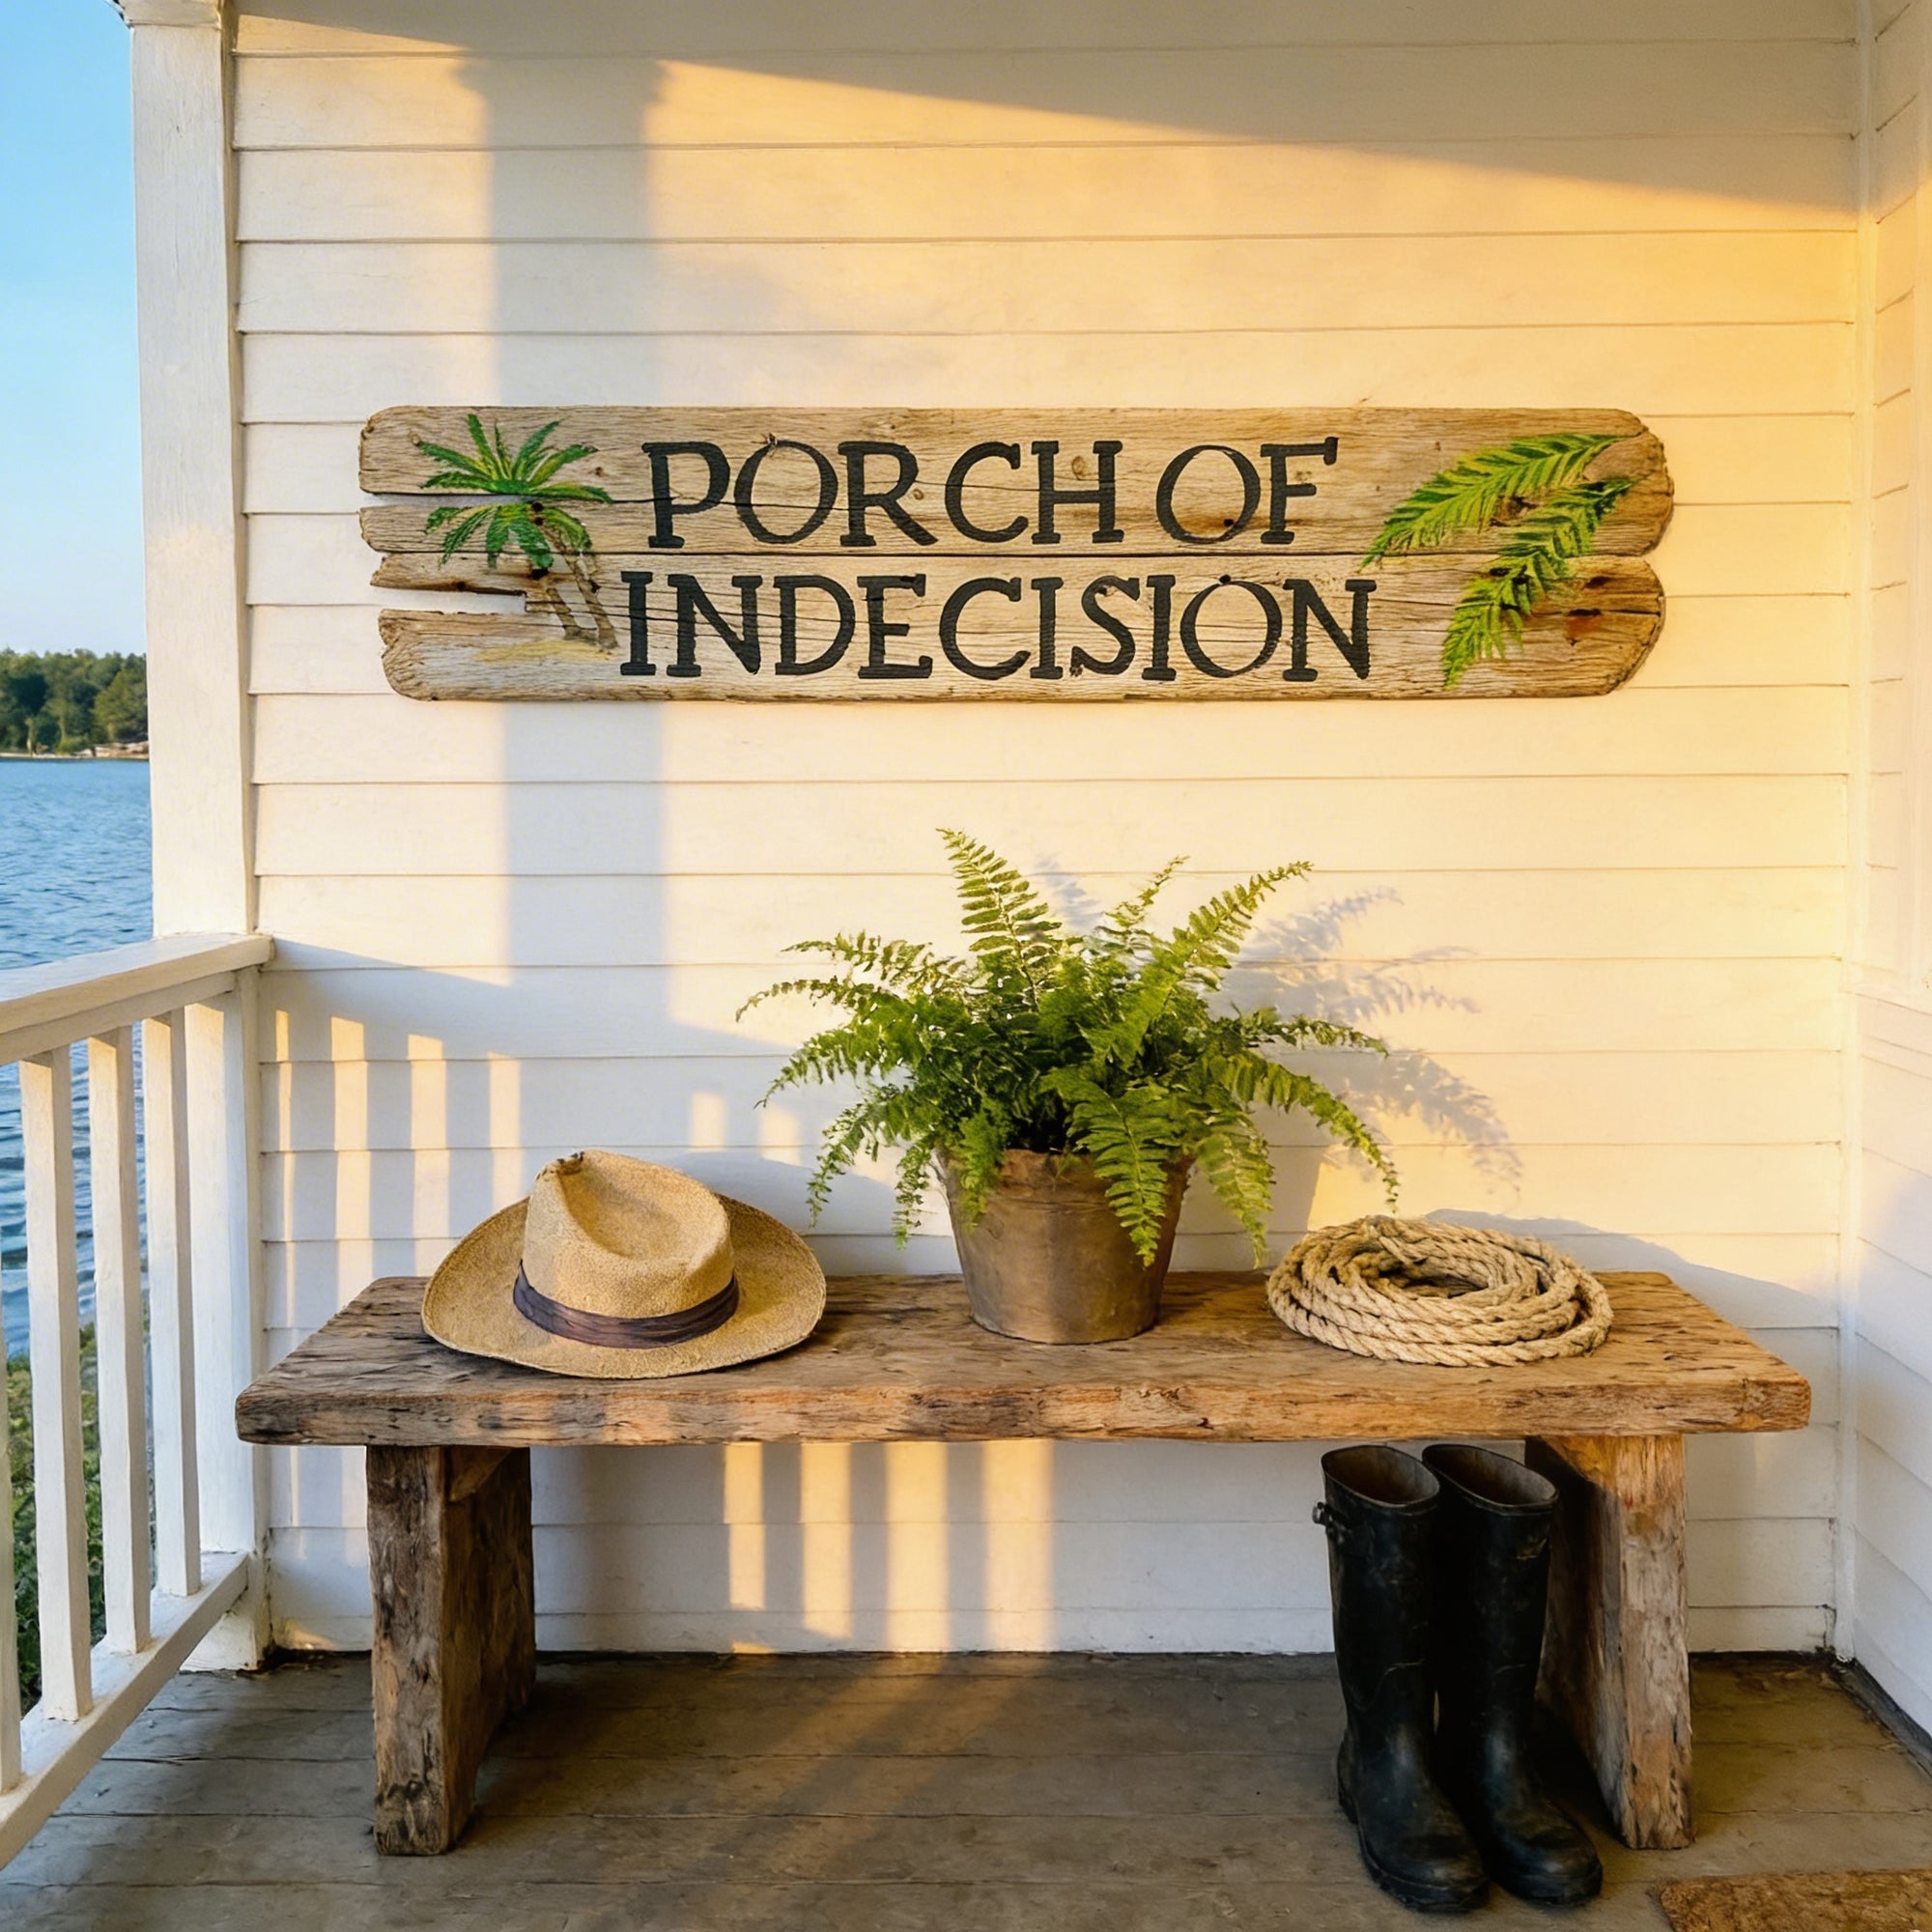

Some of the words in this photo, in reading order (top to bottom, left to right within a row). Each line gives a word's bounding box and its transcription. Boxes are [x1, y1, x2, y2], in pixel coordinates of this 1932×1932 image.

[641, 440, 1126, 549] PORCH
[1155, 437, 1339, 545] OF
[619, 570, 1377, 682] INDECISION
